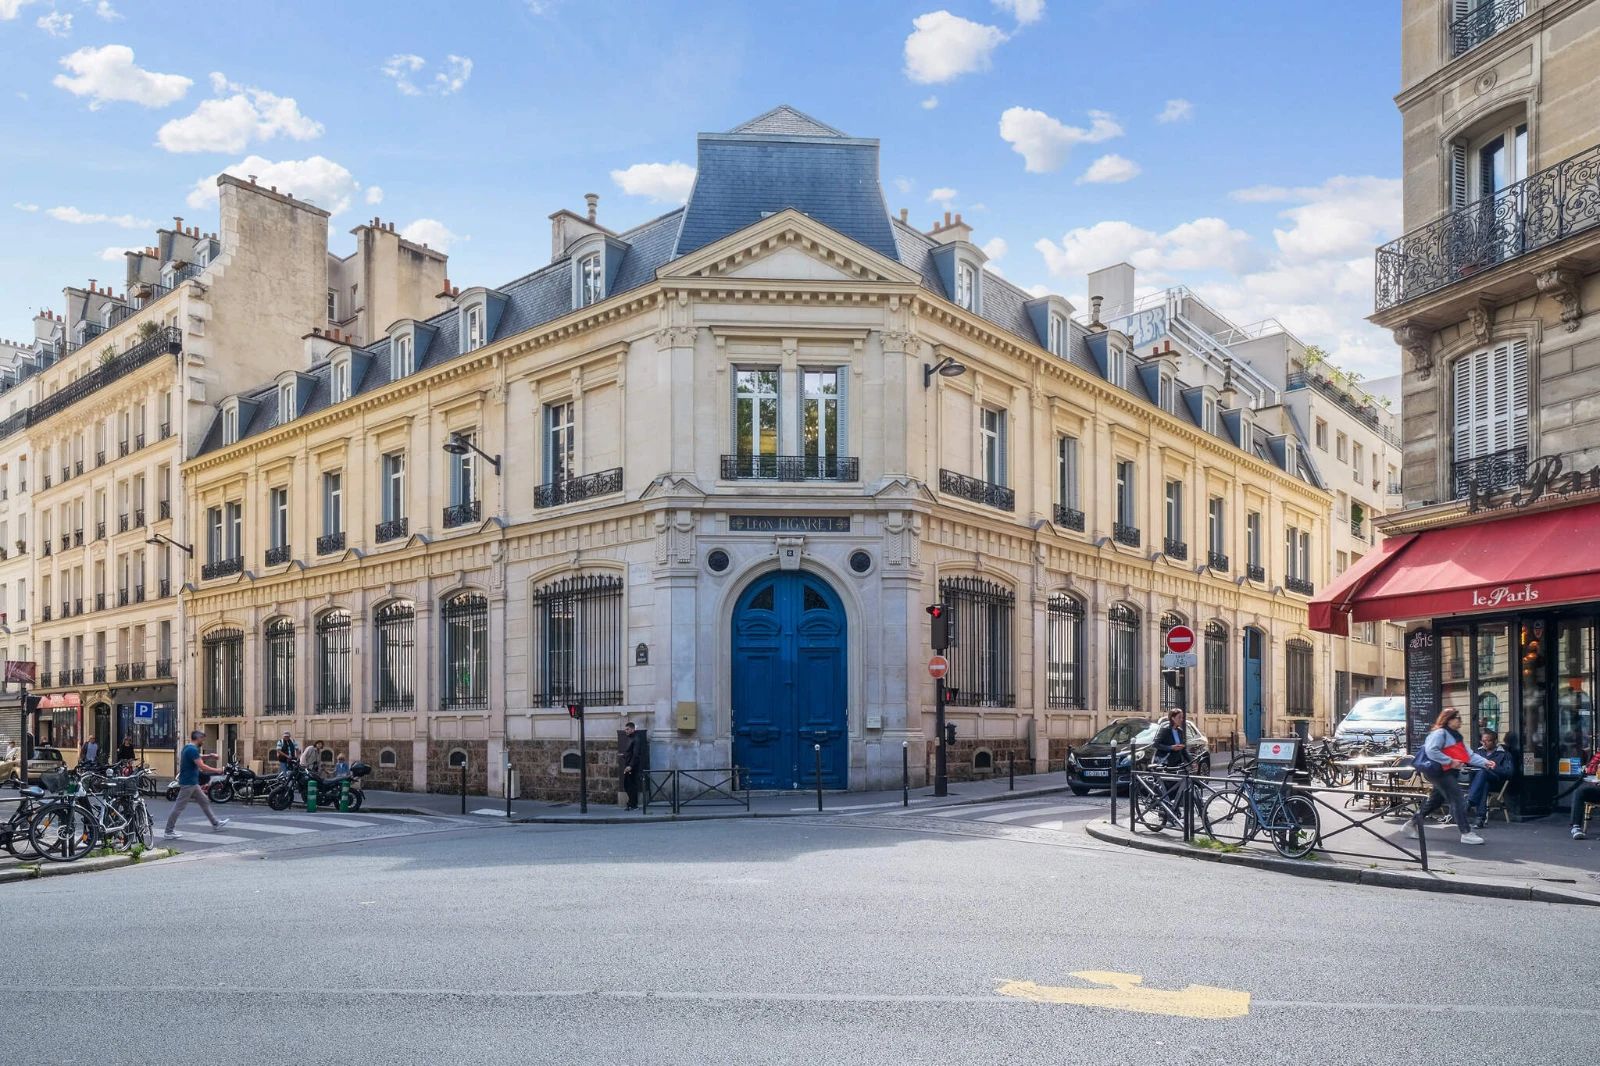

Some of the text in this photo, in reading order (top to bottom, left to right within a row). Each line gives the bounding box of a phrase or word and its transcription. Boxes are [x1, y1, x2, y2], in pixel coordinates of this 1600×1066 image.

[1473, 584, 1539, 607] le Paris
[139, 705, 148, 716] P
